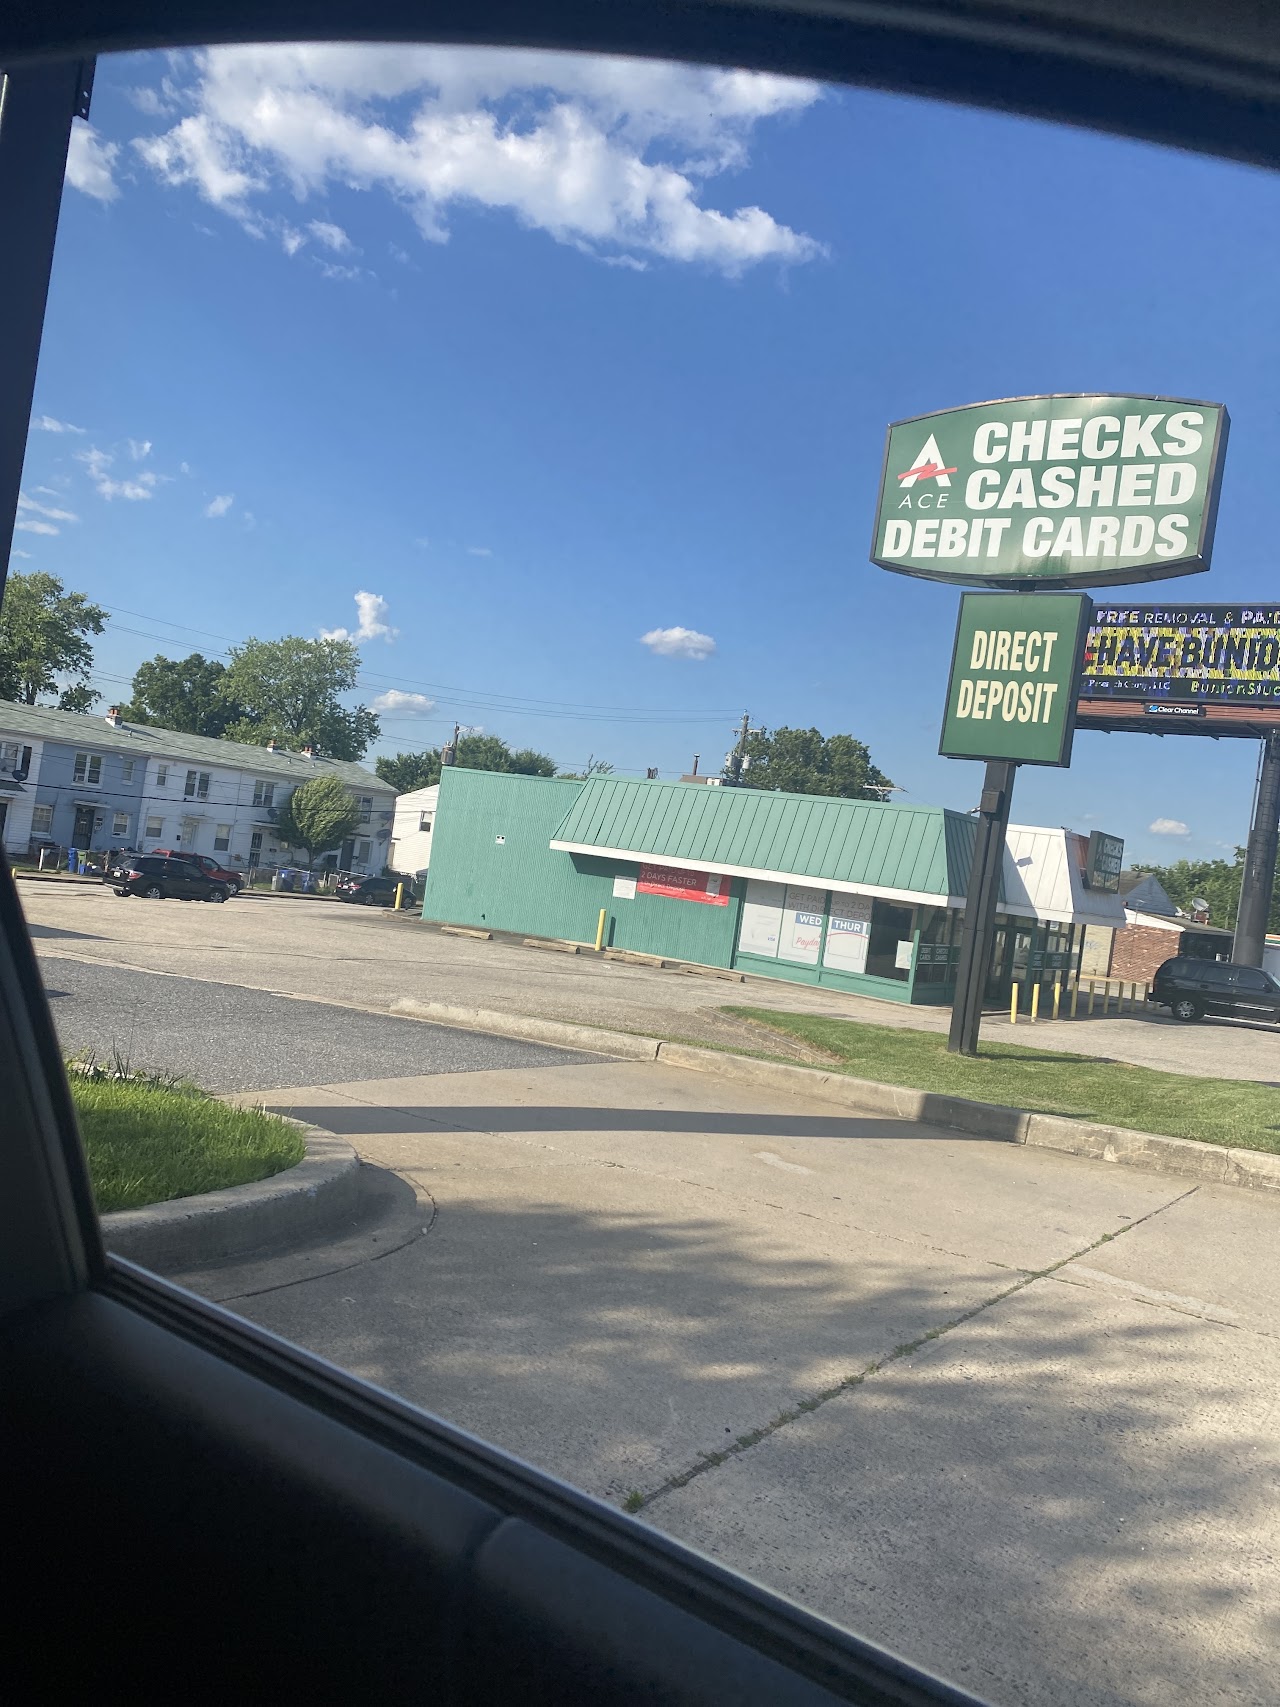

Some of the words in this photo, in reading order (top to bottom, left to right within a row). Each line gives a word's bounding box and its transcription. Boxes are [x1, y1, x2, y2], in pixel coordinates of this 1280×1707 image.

[972, 411, 1204, 463] CHECKS
[965, 462, 1198, 511] CASHED
[898, 493, 950, 509] ACE
[881, 518, 1012, 558] DEBIT
[1022, 513, 1190, 558] CARDS
[969, 630, 1059, 673] DIRECT
[1097, 636, 1175, 667] HAVE
[956, 680, 1058, 724] DEPOSIT
[1158, 706, 1174, 714] Clear
[1174, 707, 1199, 715] Channel
[647, 872, 666, 882] DAYS
[667, 875, 697, 886] FASTER
[789, 892, 805, 901] GET
[807, 895, 826, 904] PAID
[851, 901, 857, 909] 2
[799, 915, 822, 926] WED
[834, 920, 861, 933] THUR
